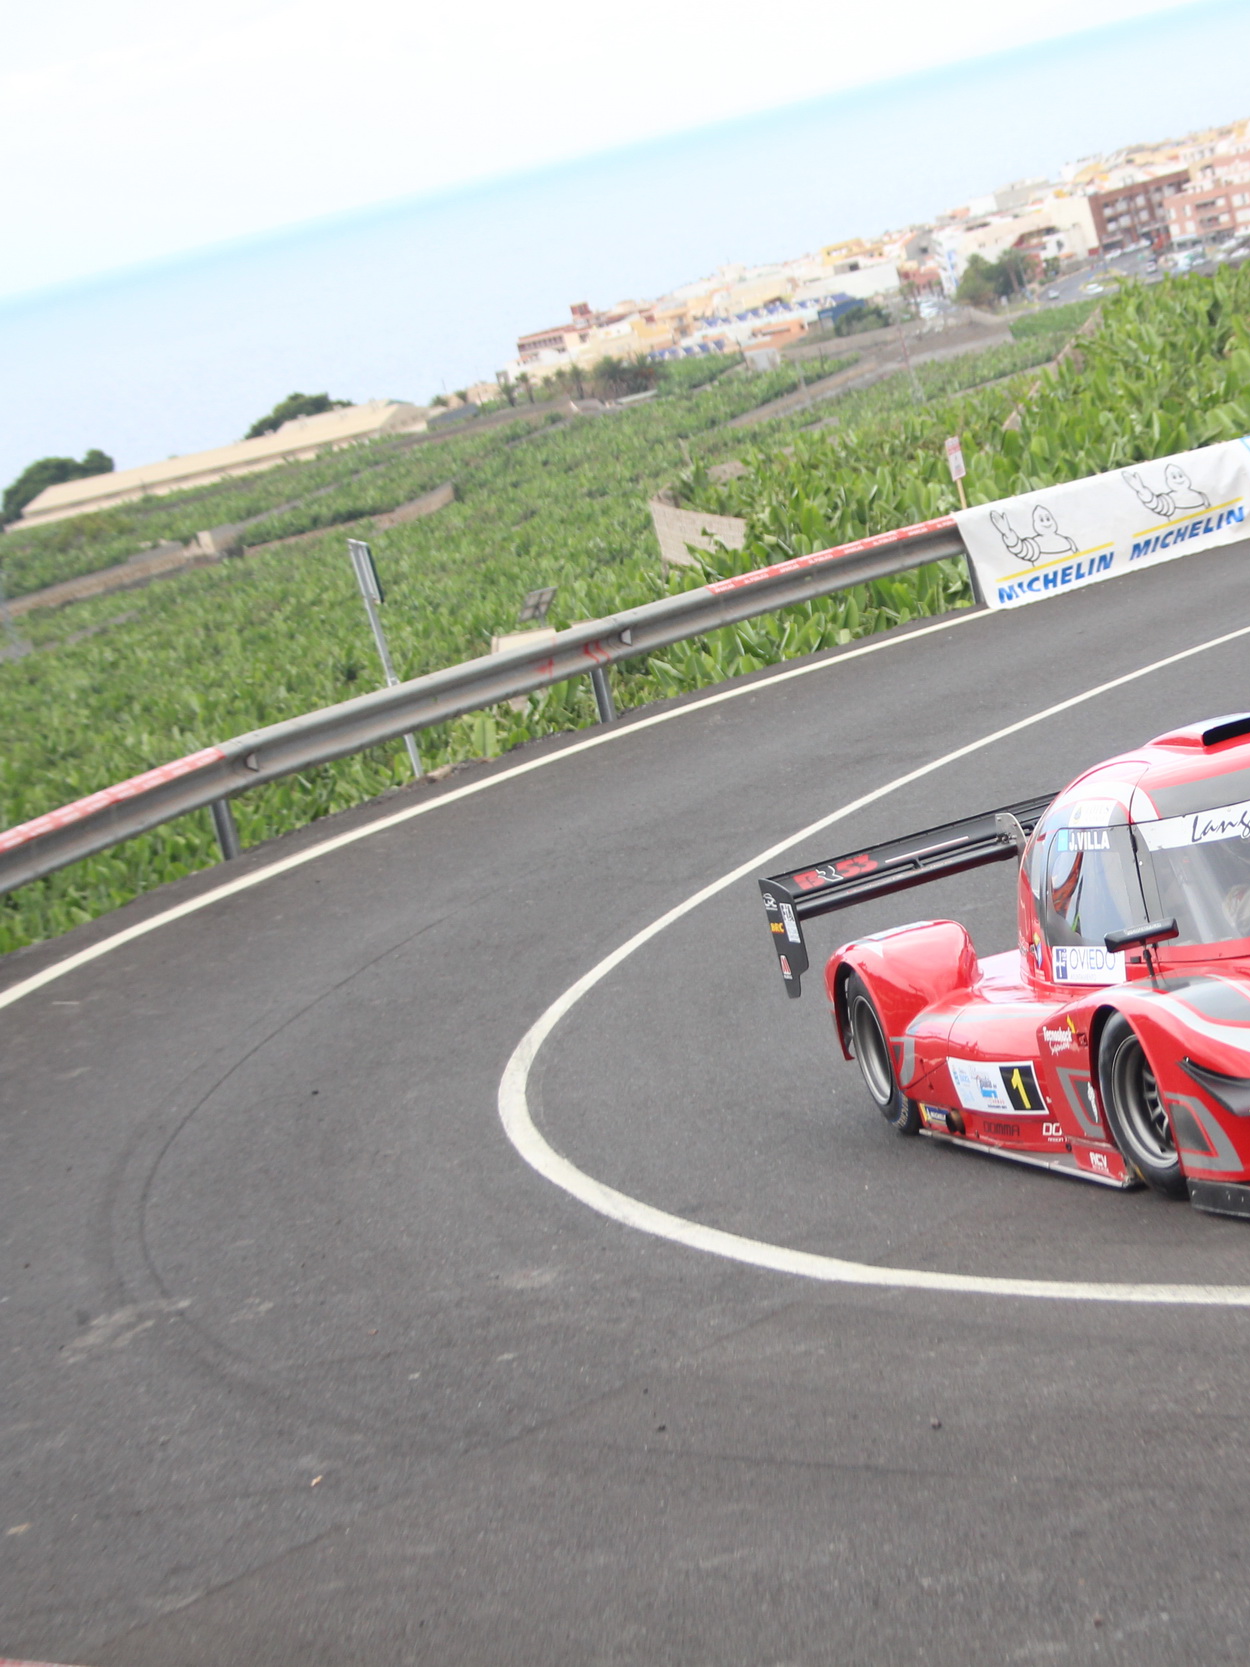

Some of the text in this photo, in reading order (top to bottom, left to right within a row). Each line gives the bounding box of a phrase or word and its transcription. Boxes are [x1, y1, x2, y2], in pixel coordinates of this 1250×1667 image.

[1129, 506, 1244, 561] MICHELIN
[998, 552, 1114, 604] MICHELIN
[1069, 830, 1111, 851] J.VILLA
[1069, 948, 1116, 970] OVIEDO
[1011, 1067, 1032, 1109] 1
[983, 1120, 1020, 1136] DOMMA
